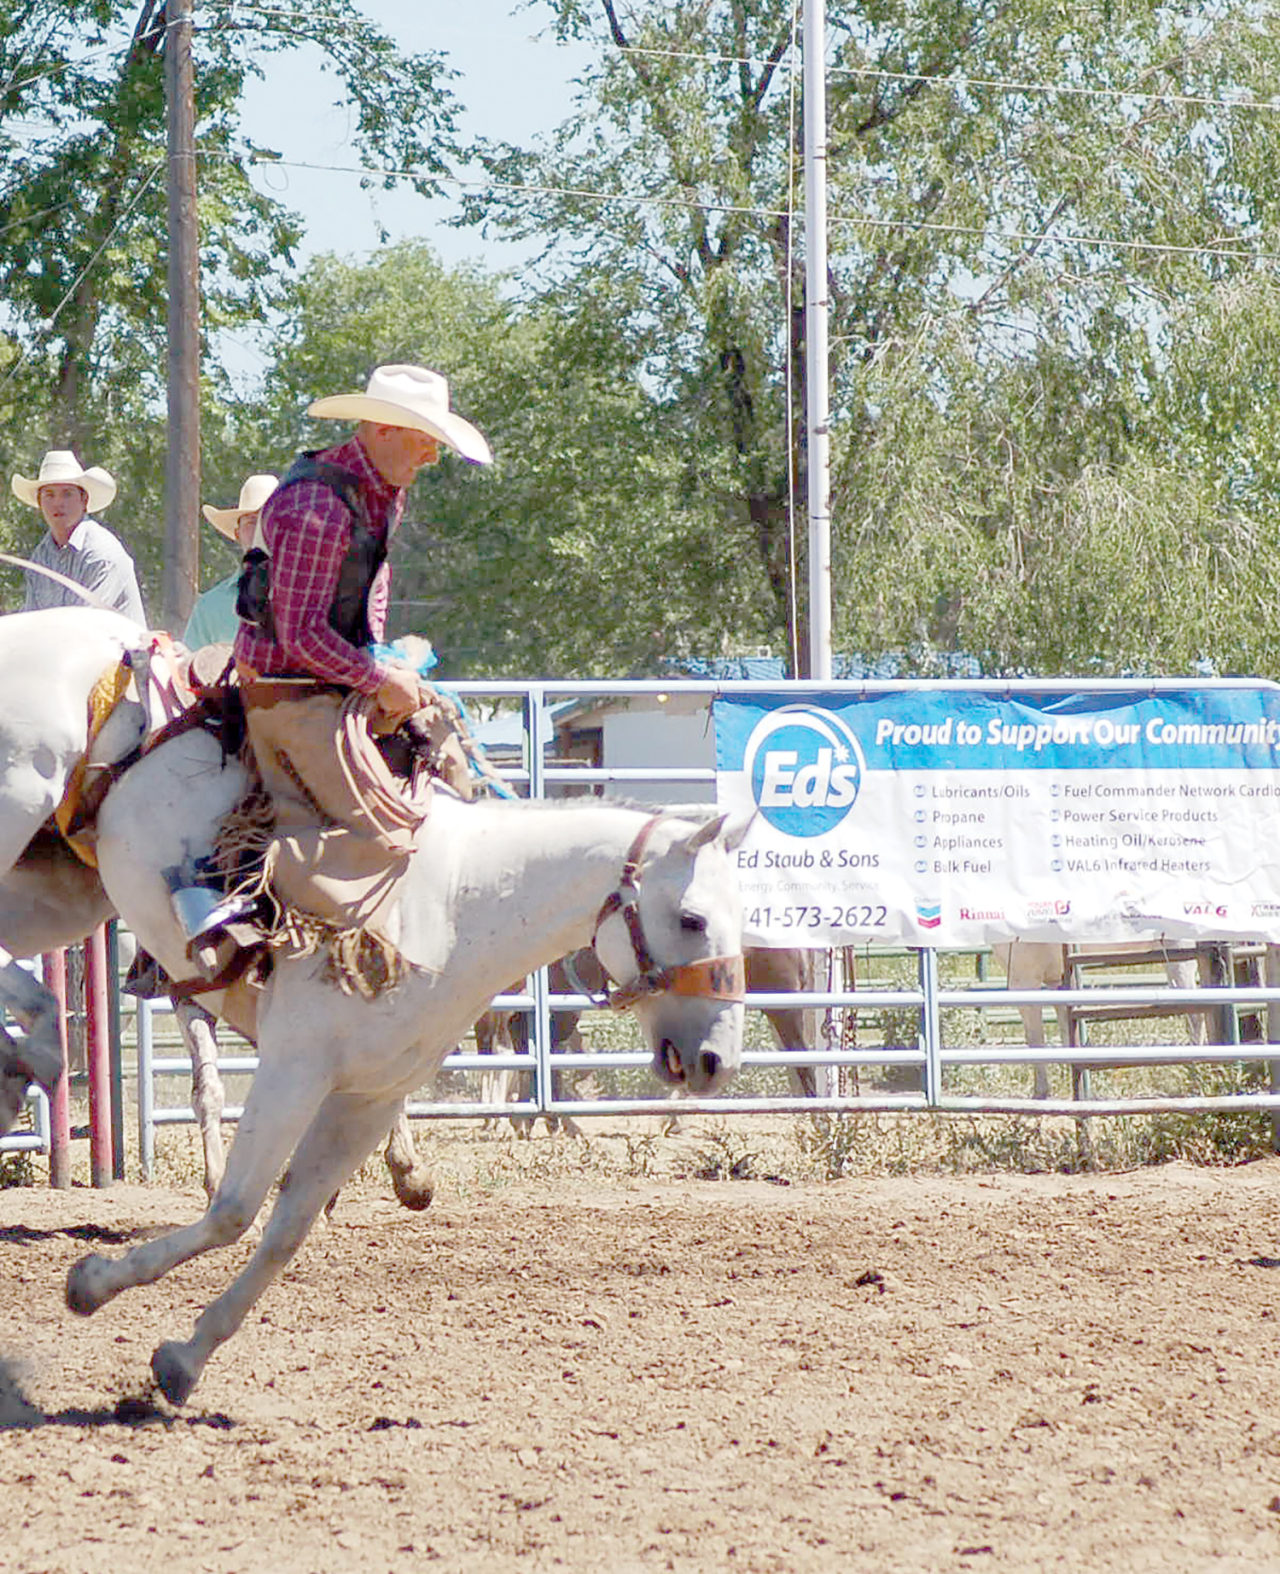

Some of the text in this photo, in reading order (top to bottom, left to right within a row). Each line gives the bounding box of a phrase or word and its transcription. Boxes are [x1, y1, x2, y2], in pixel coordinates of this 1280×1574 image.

[875, 717, 954, 746] Proud
[956, 718, 982, 746] to
[986, 717, 1091, 752] Support
[1093, 719, 1141, 745] Our
[758, 747, 858, 809] Eds
[932, 785, 1030, 799] Lubricants/Oils
[1064, 784, 1092, 798] Fuel
[1094, 784, 1176, 798] Commander
[1179, 784, 1236, 798] Network
[932, 810, 986, 826] Propane
[1063, 808, 1218, 822] Power Service Products
[933, 835, 1004, 851] Appliances
[1065, 833, 1207, 850] Heating Oil/Kerosene
[737, 850, 880, 869] Ed Staub & Sons
[933, 860, 992, 873] Bulk Fuel
[1066, 857, 1211, 872] VAL6 Infrared Heaters
[744, 905, 887, 928] 41-573-2622
